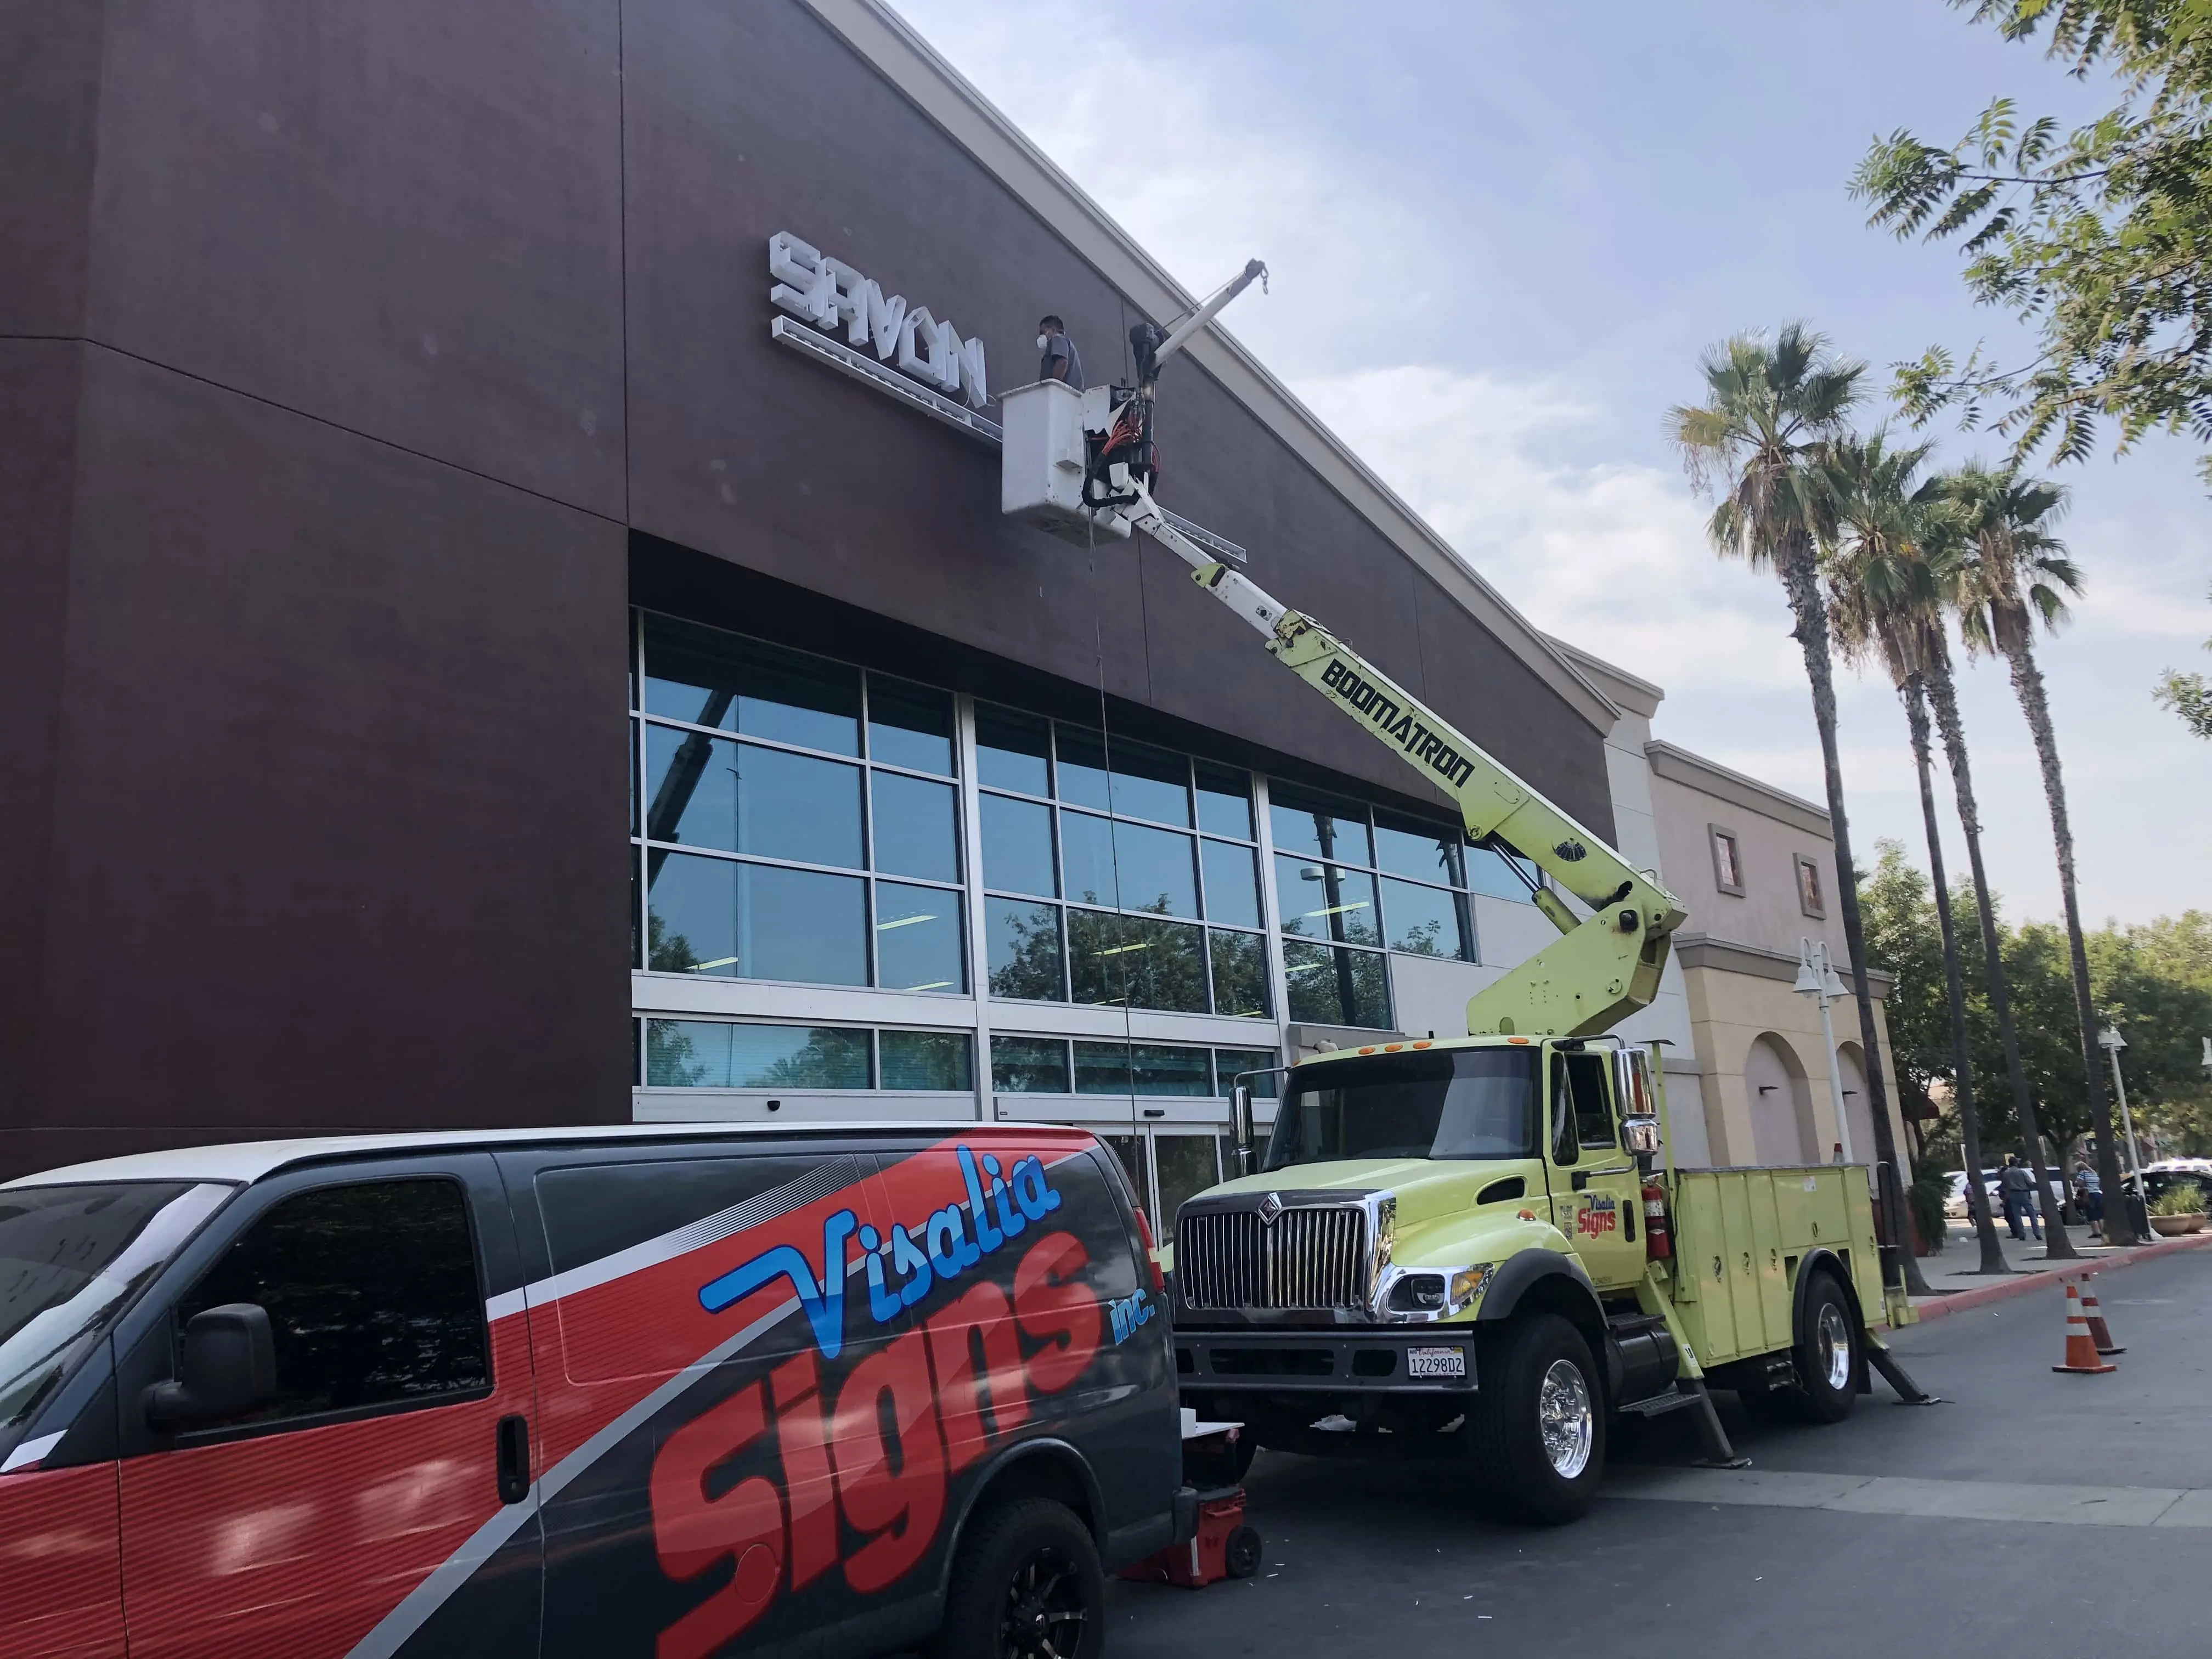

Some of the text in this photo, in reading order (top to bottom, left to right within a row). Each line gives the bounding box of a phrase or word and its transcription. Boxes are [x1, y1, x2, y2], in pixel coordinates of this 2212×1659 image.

[769, 230, 988, 409] SAVON
[1321, 658, 1476, 788] BOOMATRON
[698, 1144, 1062, 1359] Visalia
[1577, 1206, 1616, 1240] Signs
[1584, 1194, 1616, 1211] Visalia
[1412, 1357, 1463, 1373] 12298D2
[650, 1230, 1103, 1659] Signs
